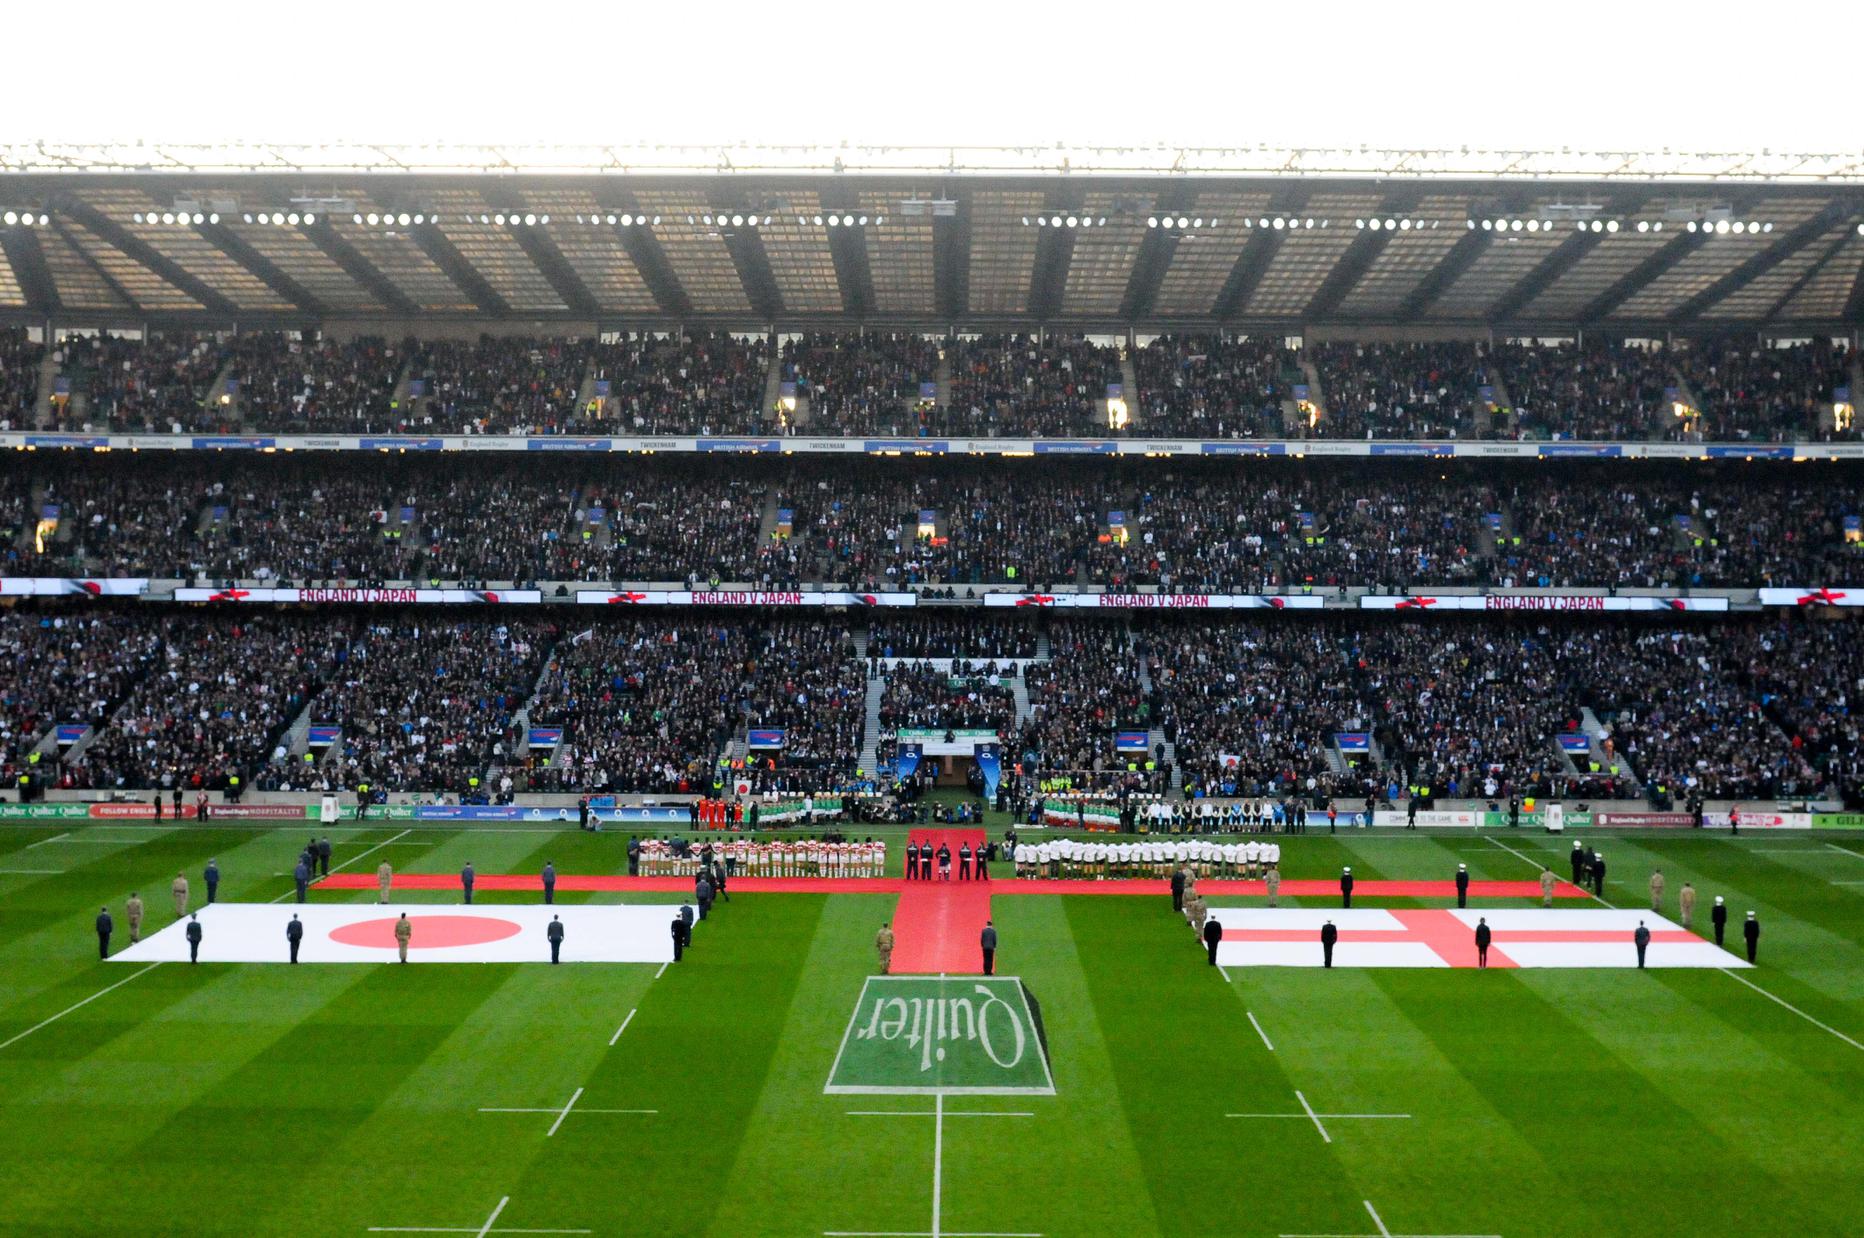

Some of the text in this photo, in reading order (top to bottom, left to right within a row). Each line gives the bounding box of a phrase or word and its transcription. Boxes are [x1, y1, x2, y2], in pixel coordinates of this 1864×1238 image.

[299, 589, 417, 602] ENGLAND V JAPAN
[692, 592, 801, 605] ENGLAND V JAPAN
[1099, 594, 1208, 607] ENGLAND V JAPAN
[1486, 596, 1604, 609] ENGLAND V JAPAN
[857, 984, 1025, 1072] Quilter
